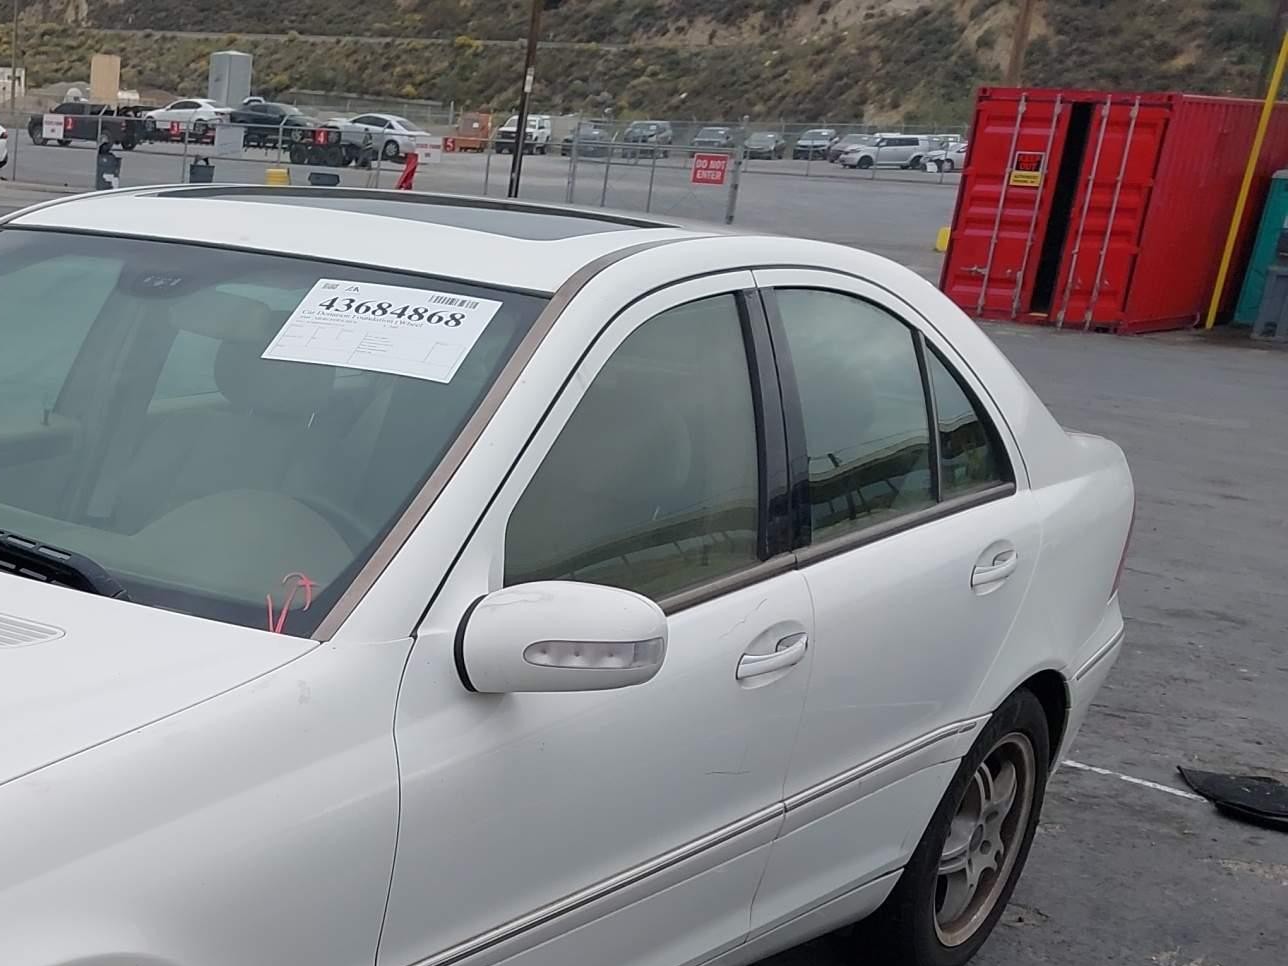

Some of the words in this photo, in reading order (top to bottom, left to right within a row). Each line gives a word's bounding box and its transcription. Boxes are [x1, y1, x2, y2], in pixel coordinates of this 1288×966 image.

[696, 159, 708, 168] DO
[709, 160, 726, 169] NOT
[696, 170, 722, 179] ENTER
[318, 296, 466, 327] 43684868
